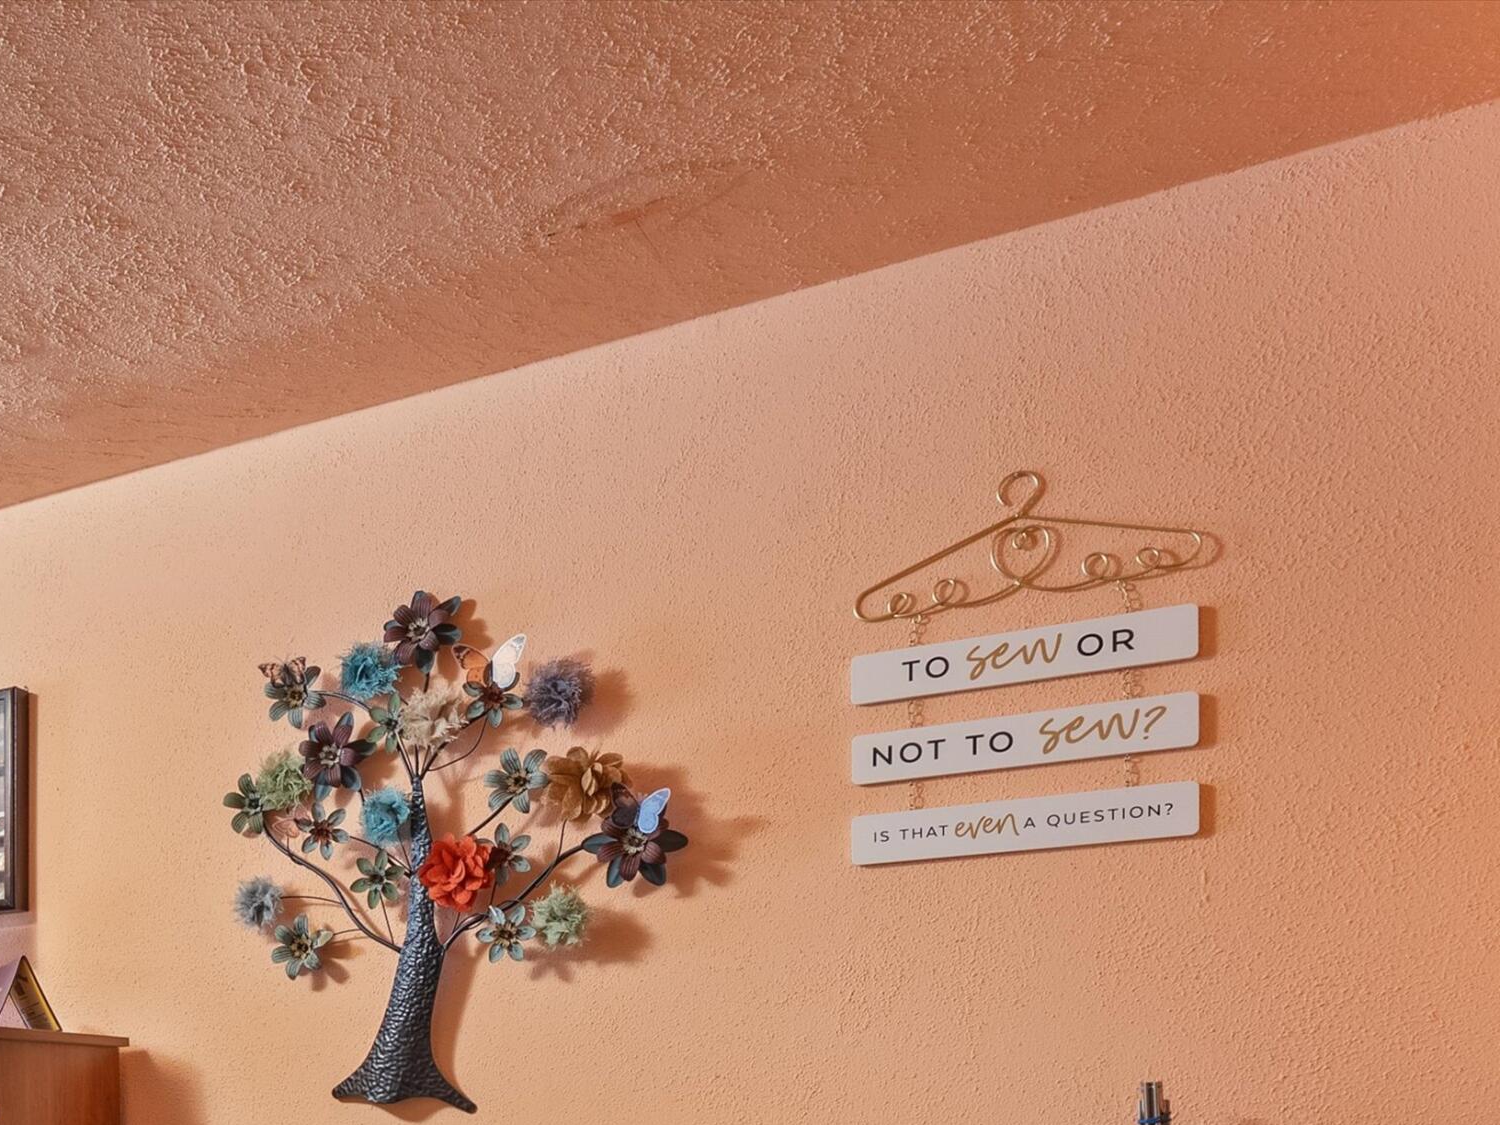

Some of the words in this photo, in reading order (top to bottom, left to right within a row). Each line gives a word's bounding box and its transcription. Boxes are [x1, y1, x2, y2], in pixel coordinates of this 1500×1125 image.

[901, 656, 950, 682] TO
[964, 632, 1062, 681] sew
[1076, 628, 1136, 657] OR
[871, 738, 947, 768] NOT
[965, 730, 1014, 756] TO
[1038, 704, 1167, 755] sew?
[873, 830, 890, 843] IS
[899, 823, 949, 842] THAT
[954, 812, 1020, 840] even
[1023, 816, 1036, 830] A
[1046, 802, 1174, 828] QUESTION?
